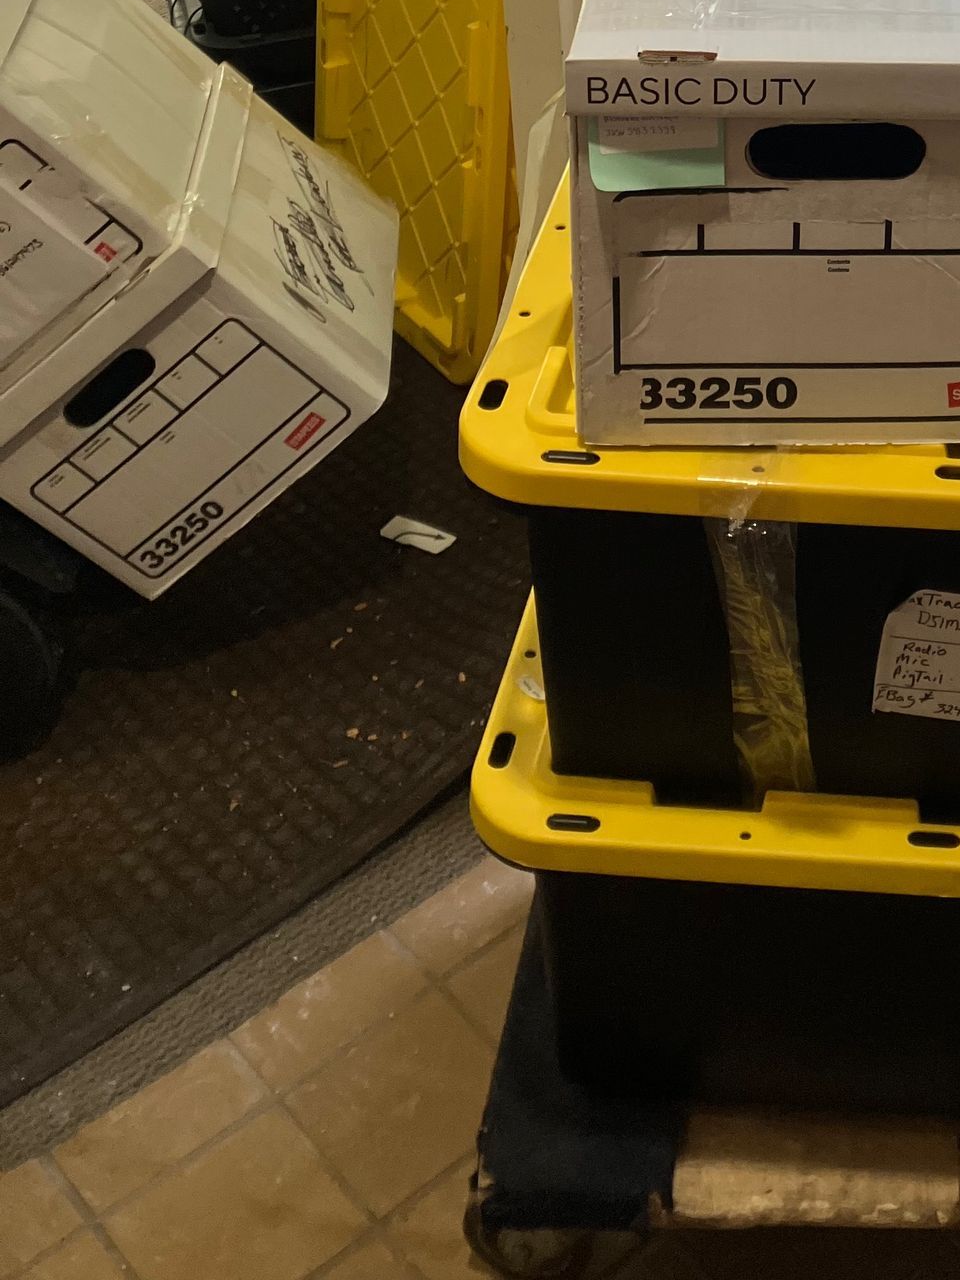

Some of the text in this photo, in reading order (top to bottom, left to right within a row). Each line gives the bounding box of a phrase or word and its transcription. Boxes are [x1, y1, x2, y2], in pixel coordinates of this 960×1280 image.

[586, 77, 817, 107] BASIC DUTY
[640, 376, 798, 411] 33250
[140, 500, 225, 570] 33250
[895, 654, 930, 667] Mic
[902, 641, 948, 656] Radio
